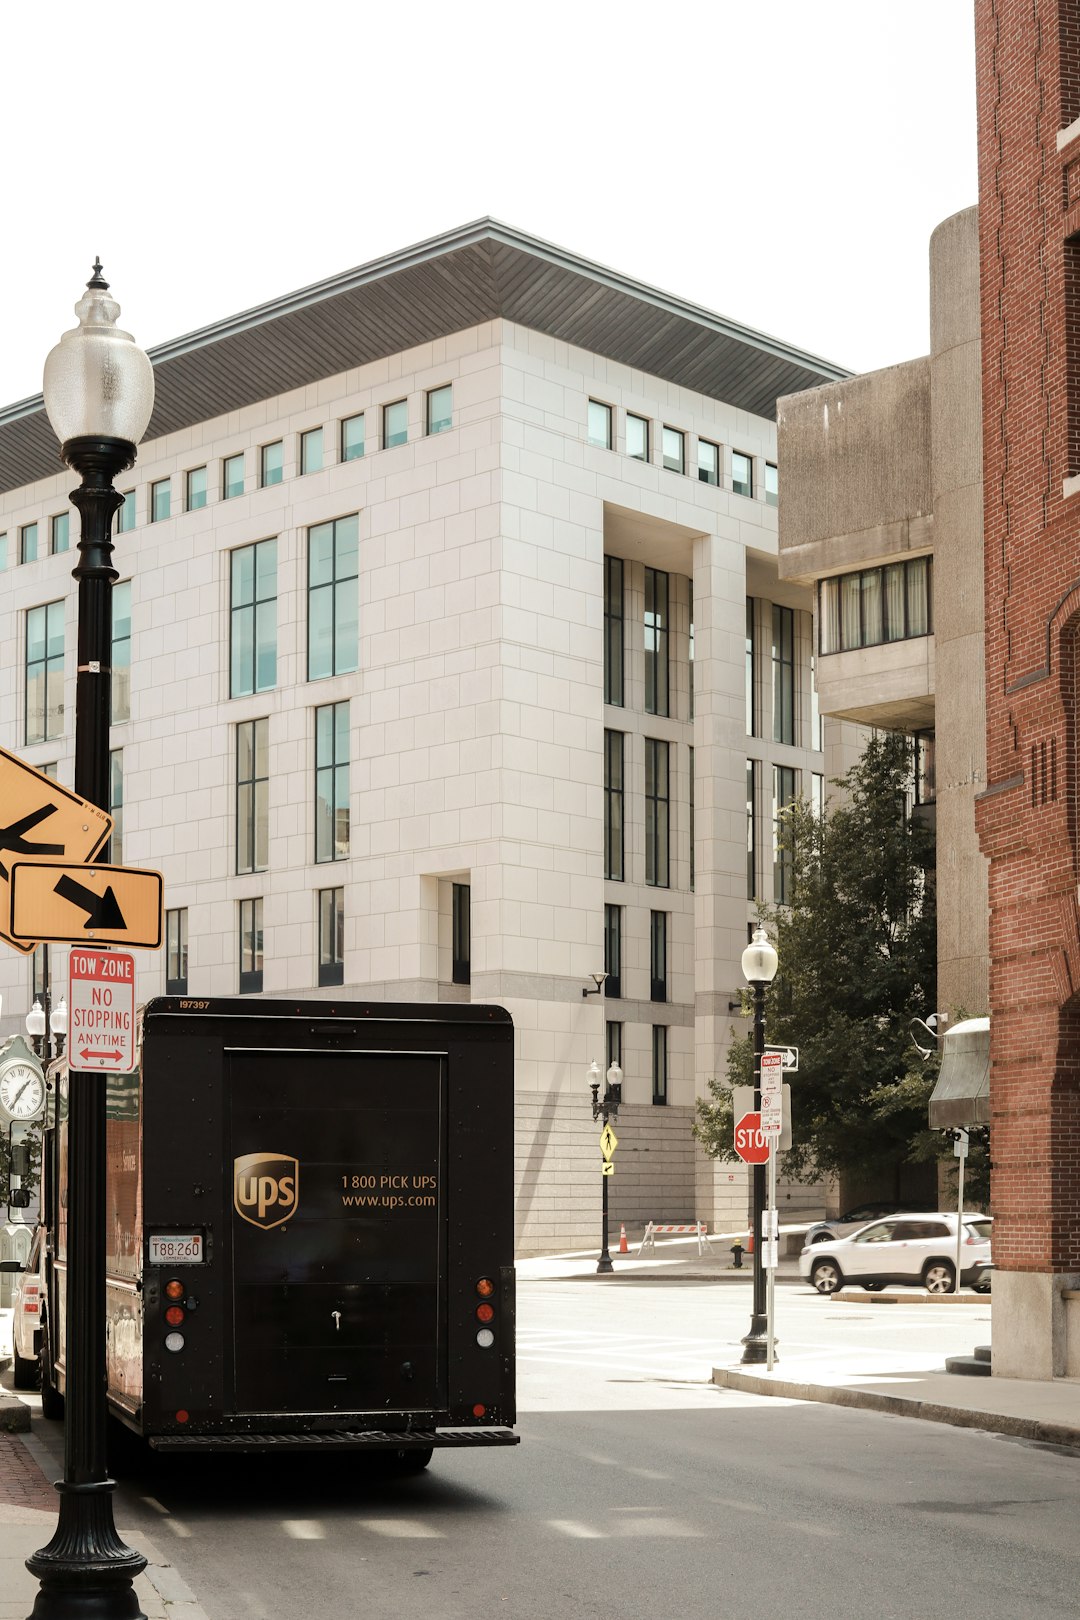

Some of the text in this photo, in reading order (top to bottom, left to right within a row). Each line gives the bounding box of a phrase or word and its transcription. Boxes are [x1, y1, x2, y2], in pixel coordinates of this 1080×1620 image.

[73, 956, 132, 978] TOW ZONE
[92, 987, 113, 1007] NO
[179, 1000, 210, 1009] 197397
[74, 1008, 130, 1030] STOPPING
[77, 1033, 126, 1047] ANYTIME
[341, 1175, 437, 1189] 1 800 PICK UPS
[238, 1176, 295, 1218] ups
[342, 1195, 436, 1210] www.ups.com
